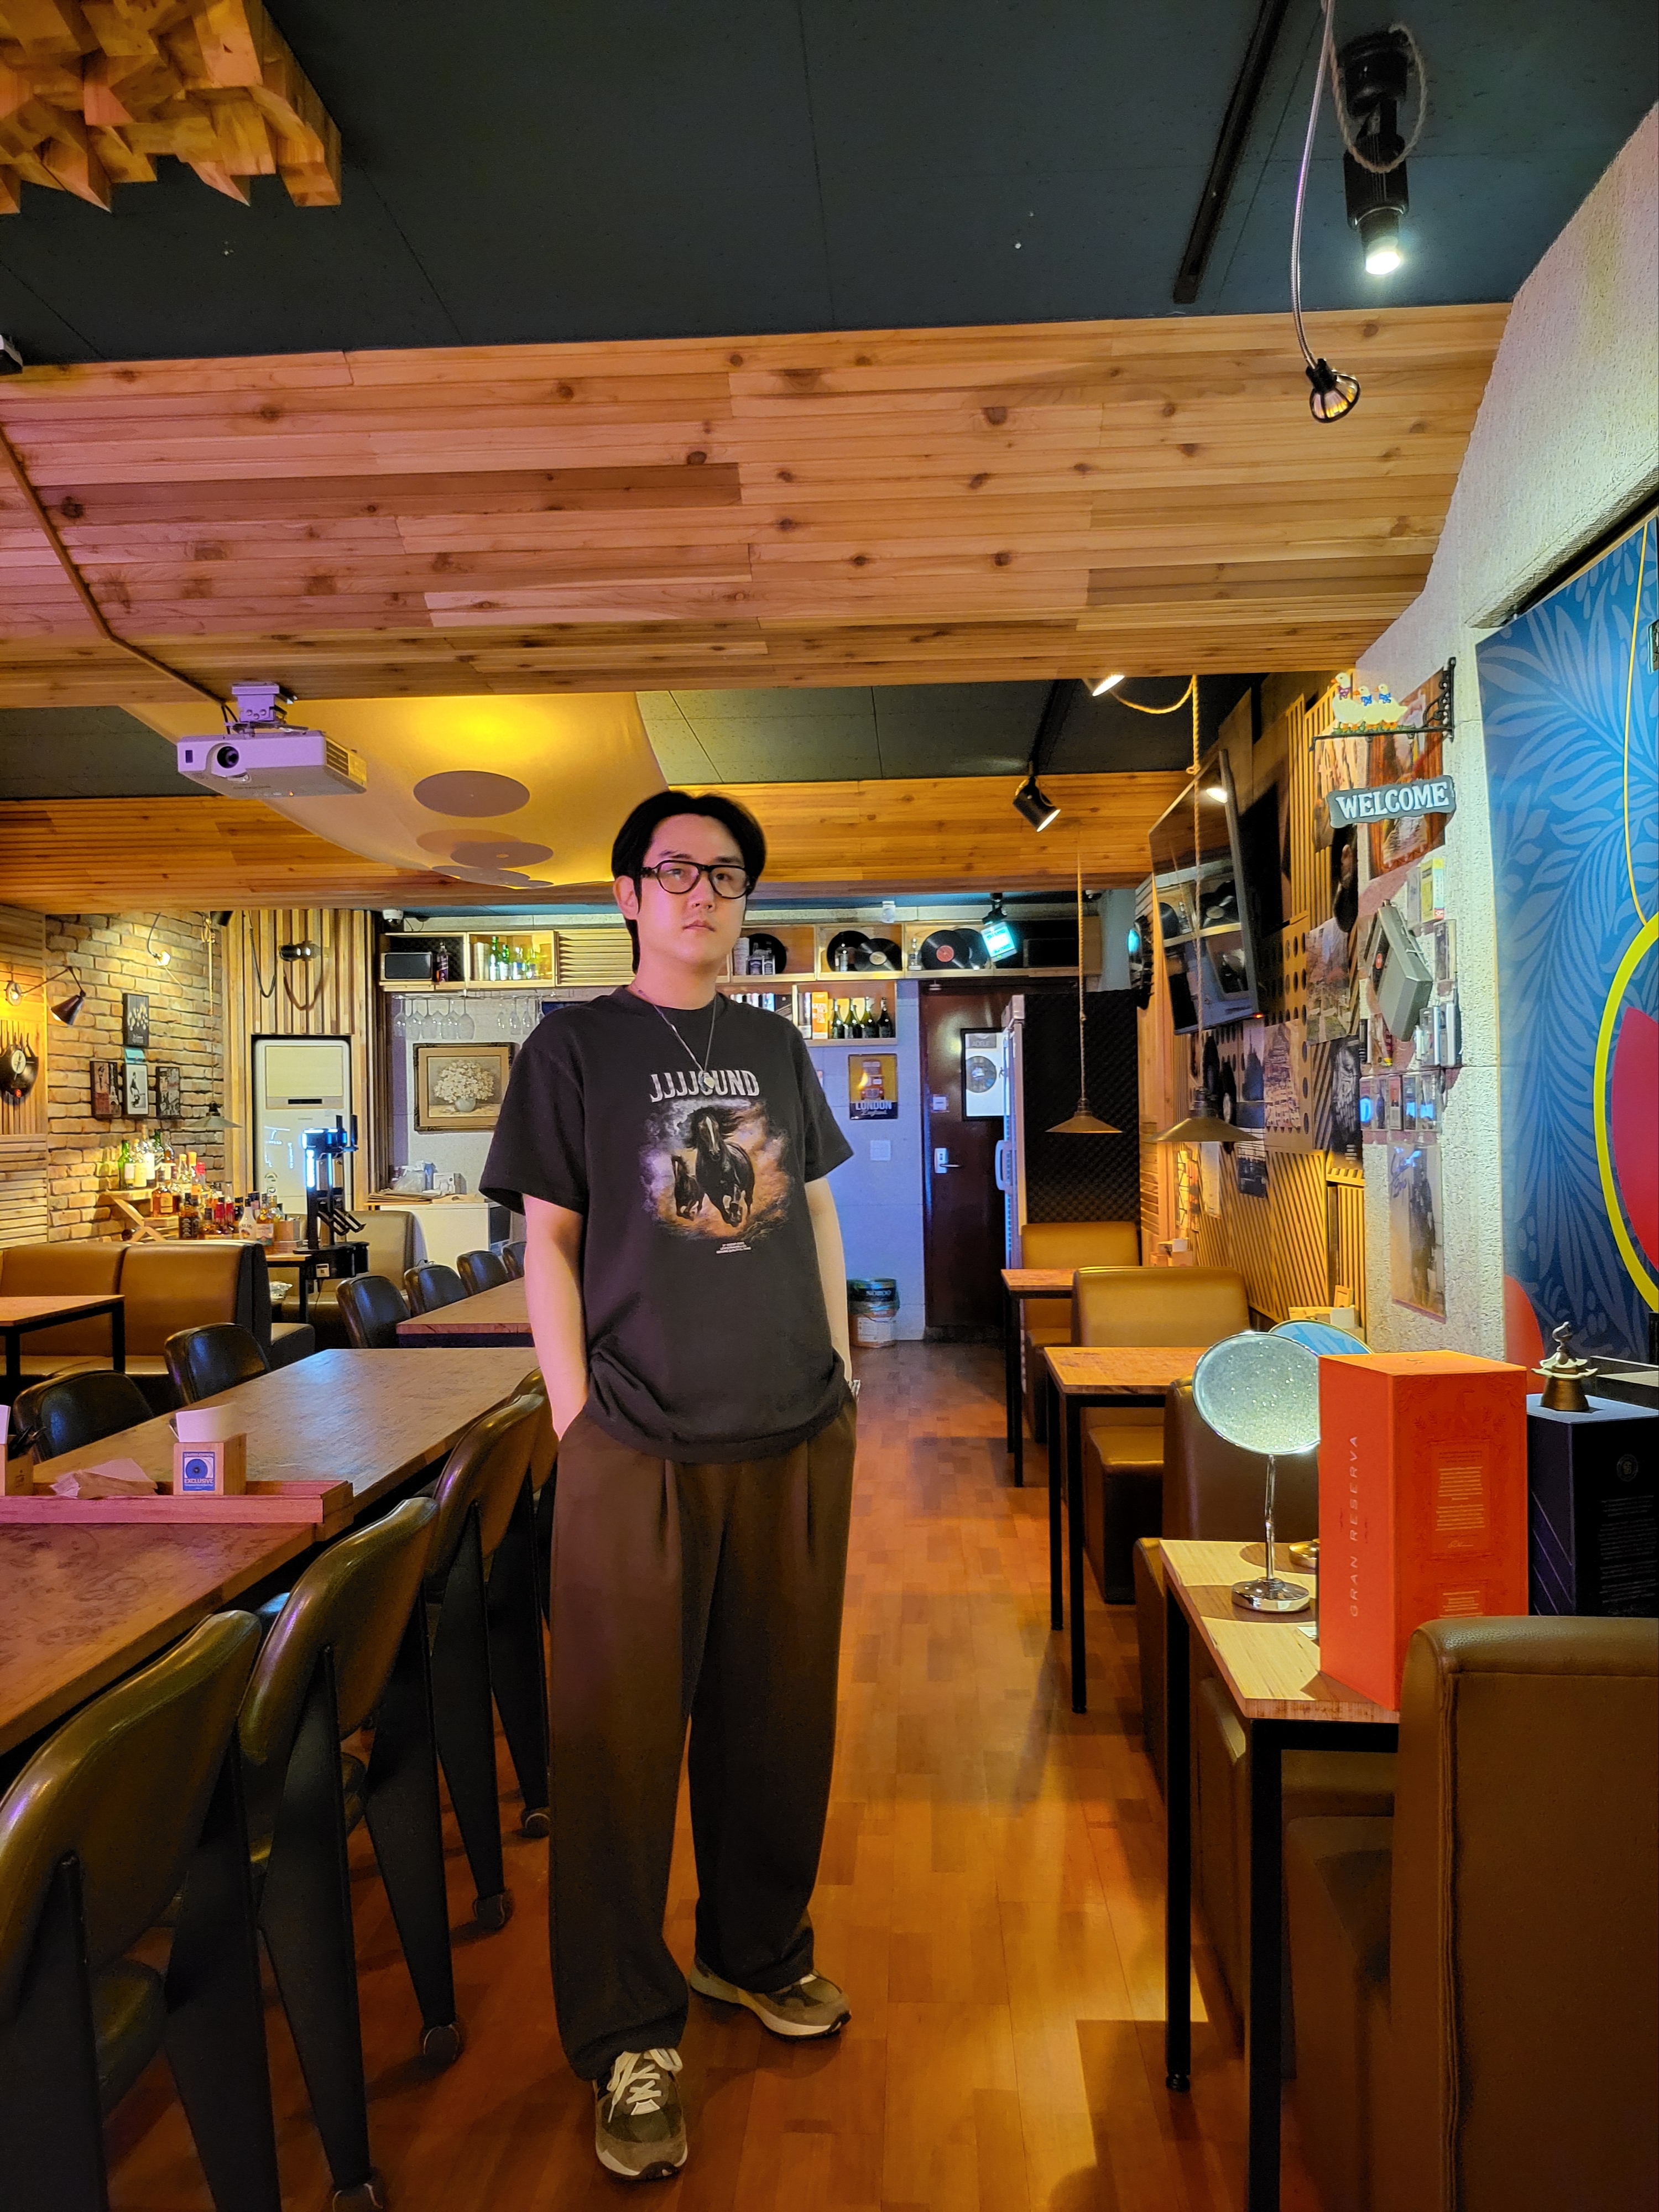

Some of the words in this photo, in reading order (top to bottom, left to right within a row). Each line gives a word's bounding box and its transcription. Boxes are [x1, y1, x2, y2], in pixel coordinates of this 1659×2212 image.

[1335, 781, 1450, 819] WELCOME
[855, 1100, 892, 1110] LONDON
[1349, 1436, 1358, 1541] RESERVA
[1349, 1556, 1358, 1617] GRAN
